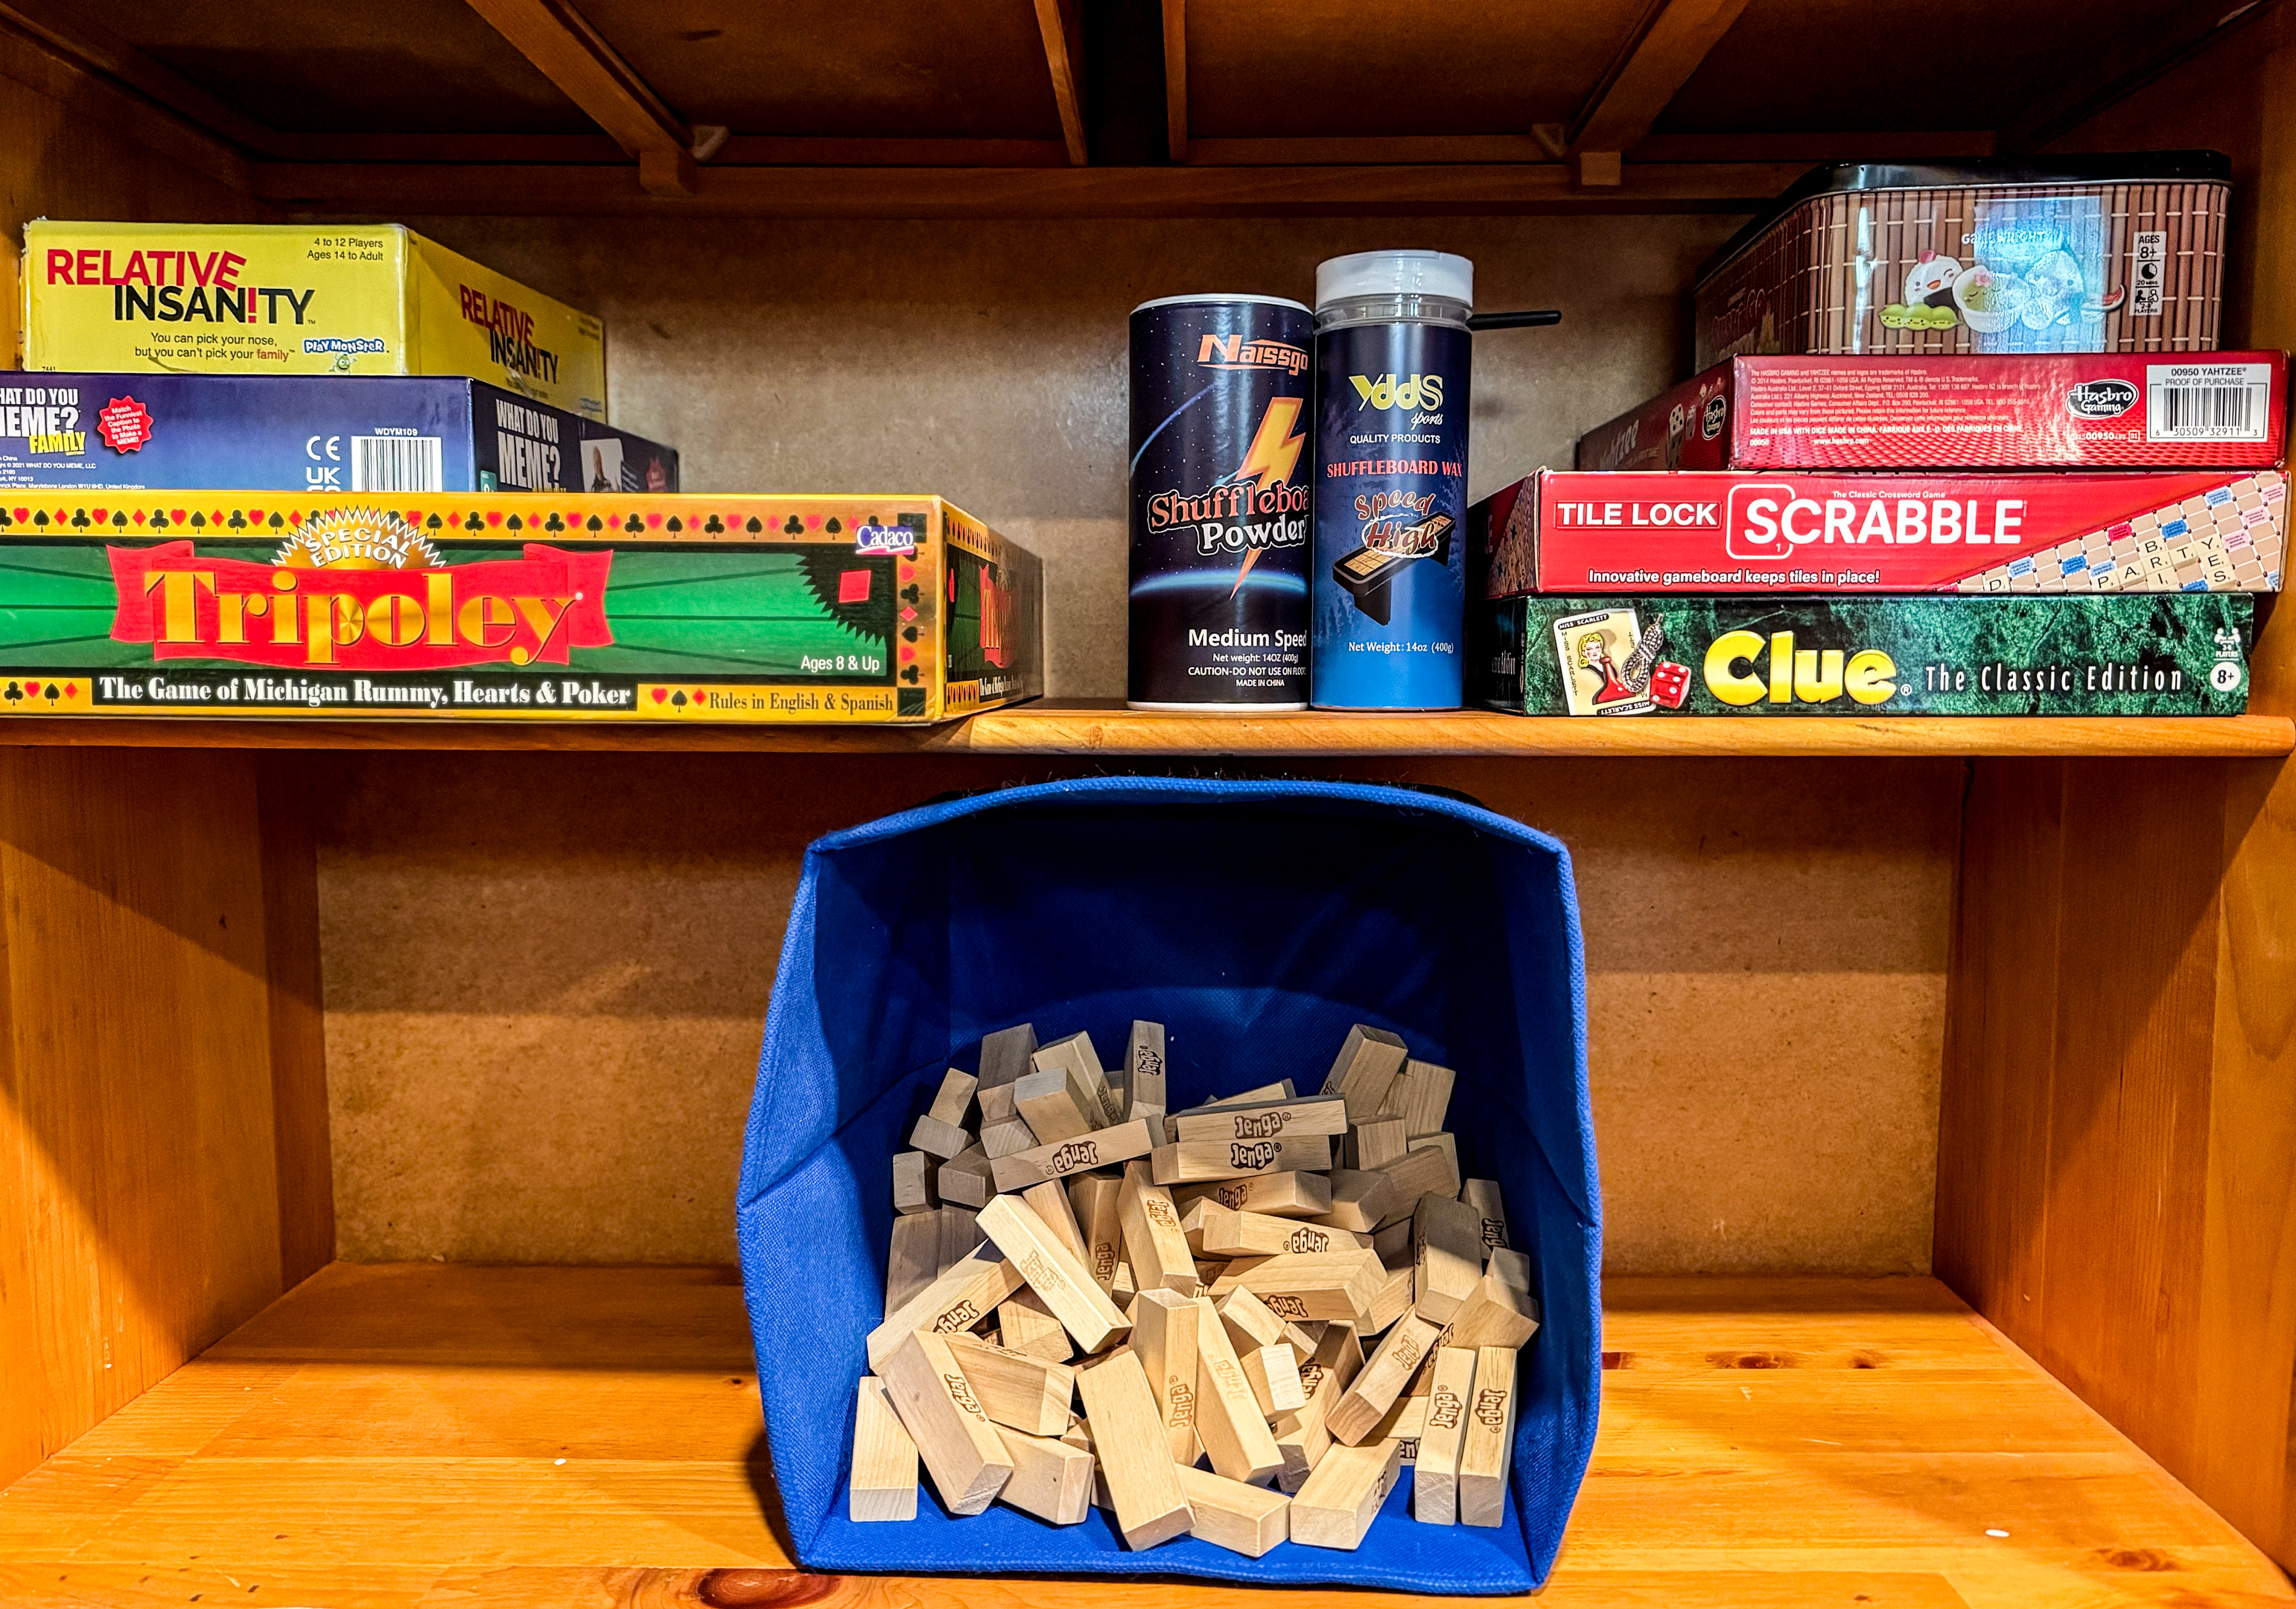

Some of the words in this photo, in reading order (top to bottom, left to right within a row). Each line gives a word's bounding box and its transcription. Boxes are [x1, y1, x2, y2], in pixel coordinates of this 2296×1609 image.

[314, 238, 321, 247] 4
[322, 238, 331, 247] to
[334, 238, 346, 247] 12
[349, 238, 384, 249] Players
[2138, 235, 2160, 244] AGES
[307, 250, 332, 261] Ages
[334, 250, 346, 260] 14
[347, 251, 357, 260] to
[359, 251, 384, 261] Adult
[2140, 247, 2157, 258] 8+
[47, 248, 247, 291] RELATIVE
[459, 283, 535, 346] RELATIVE
[151, 332, 172, 344] You
[174, 334, 194, 344] can
[197, 333, 219, 346] pick
[221, 336, 245, 347] your
[247, 337, 278, 347] nose,
[135, 346, 150, 358] but
[153, 349, 173, 361] you
[175, 347, 203, 358] can't
[205, 347, 228, 361] pick
[230, 349, 255, 361] your
[489, 329, 558, 384] INSAN!TY
[2171, 368, 2199, 376] 00950
[2204, 378, 2244, 386] PURCHASE
[25, 388, 47, 404] DO
[48, 389, 78, 405] YOU
[2070, 384, 2132, 404] Hasbro
[112, 405, 132, 414] Match
[115, 410, 143, 420] Funniest
[2081, 399, 2122, 414] Gaming
[108, 419, 133, 428] Caption
[495, 399, 525, 433] WHAT
[526, 410, 539, 438] DO
[540, 414, 559, 444] YOU
[1411, 412, 1443, 431] sports
[375, 428, 418, 436] WDYM109
[1349, 434, 1389, 445] QUALITY
[1391, 434, 1441, 444] PRODUCTS
[2174, 428, 2204, 436] 30509
[2210, 428, 2240, 436] 32911
[28, 431, 86, 454] FAMILY
[1813, 437, 1869, 445] www.hasbro.com
[497, 431, 562, 491] MEME?
[1326, 460, 1438, 479] SHUFFLEBOARD
[1442, 460, 1462, 477] WAX
[1355, 489, 1436, 521] Speed
[1557, 503, 1623, 526] TILE
[1632, 504, 1717, 527] LOCK
[1744, 498, 2023, 545] SCRABBLE
[305, 526, 409, 555] SPECIAL
[856, 526, 915, 548] Cadaco
[1201, 514, 1305, 550] Powder
[1366, 521, 1436, 555] High
[311, 543, 408, 570] EDITION
[1589, 569, 1660, 583] Innovative
[1662, 569, 1742, 586] gameboard
[1744, 569, 1786, 586] keeps
[1789, 570, 1818, 583] tiles
[1822, 571, 1834, 583] in
[1837, 570, 1880, 586] place!
[1559, 622, 1574, 630] MISS
[1577, 614, 1608, 626] SCARLETT
[1189, 628, 1270, 647] Medium
[1274, 629, 1307, 652] Speed
[1349, 641, 1363, 652] Net
[1366, 641, 1404, 654] Weight:
[1406, 641, 1428, 653] 14oz
[1431, 641, 1454, 654] (400g)
[801, 656, 833, 673] Ages
[836, 656, 845, 670] 8
[848, 656, 859, 670] &
[862, 656, 880, 673] Up
[1212, 653, 1229, 662] Net
[1230, 653, 1261, 664] weight:
[1262, 653, 1281, 662] 14OZ
[1282, 653, 1299, 664] (400g)
[1188, 667, 1246, 676] CAUTION-DO
[1249, 667, 1266, 676] NOT
[1268, 667, 1282, 676] USE
[1282, 667, 1292, 676] ON
[1925, 665, 1965, 692] The
[1982, 664, 2071, 692] Classic
[2087, 664, 2183, 692] Edition
[2217, 670, 2234, 684] 8+
[100, 676, 144, 700] The
[148, 678, 213, 702] Game
[217, 677, 241, 701] of
[244, 679, 350, 708] Michigan
[353, 681, 448, 709] Rummy,
[454, 681, 530, 705] Hearts
[535, 682, 557, 704] &
[561, 682, 632, 705] Poker
[710, 692, 747, 710] Rules
[752, 693, 764, 709] in
[769, 692, 823, 714] English
[824, 694, 836, 710] &
[841, 692, 894, 716] Spanish
